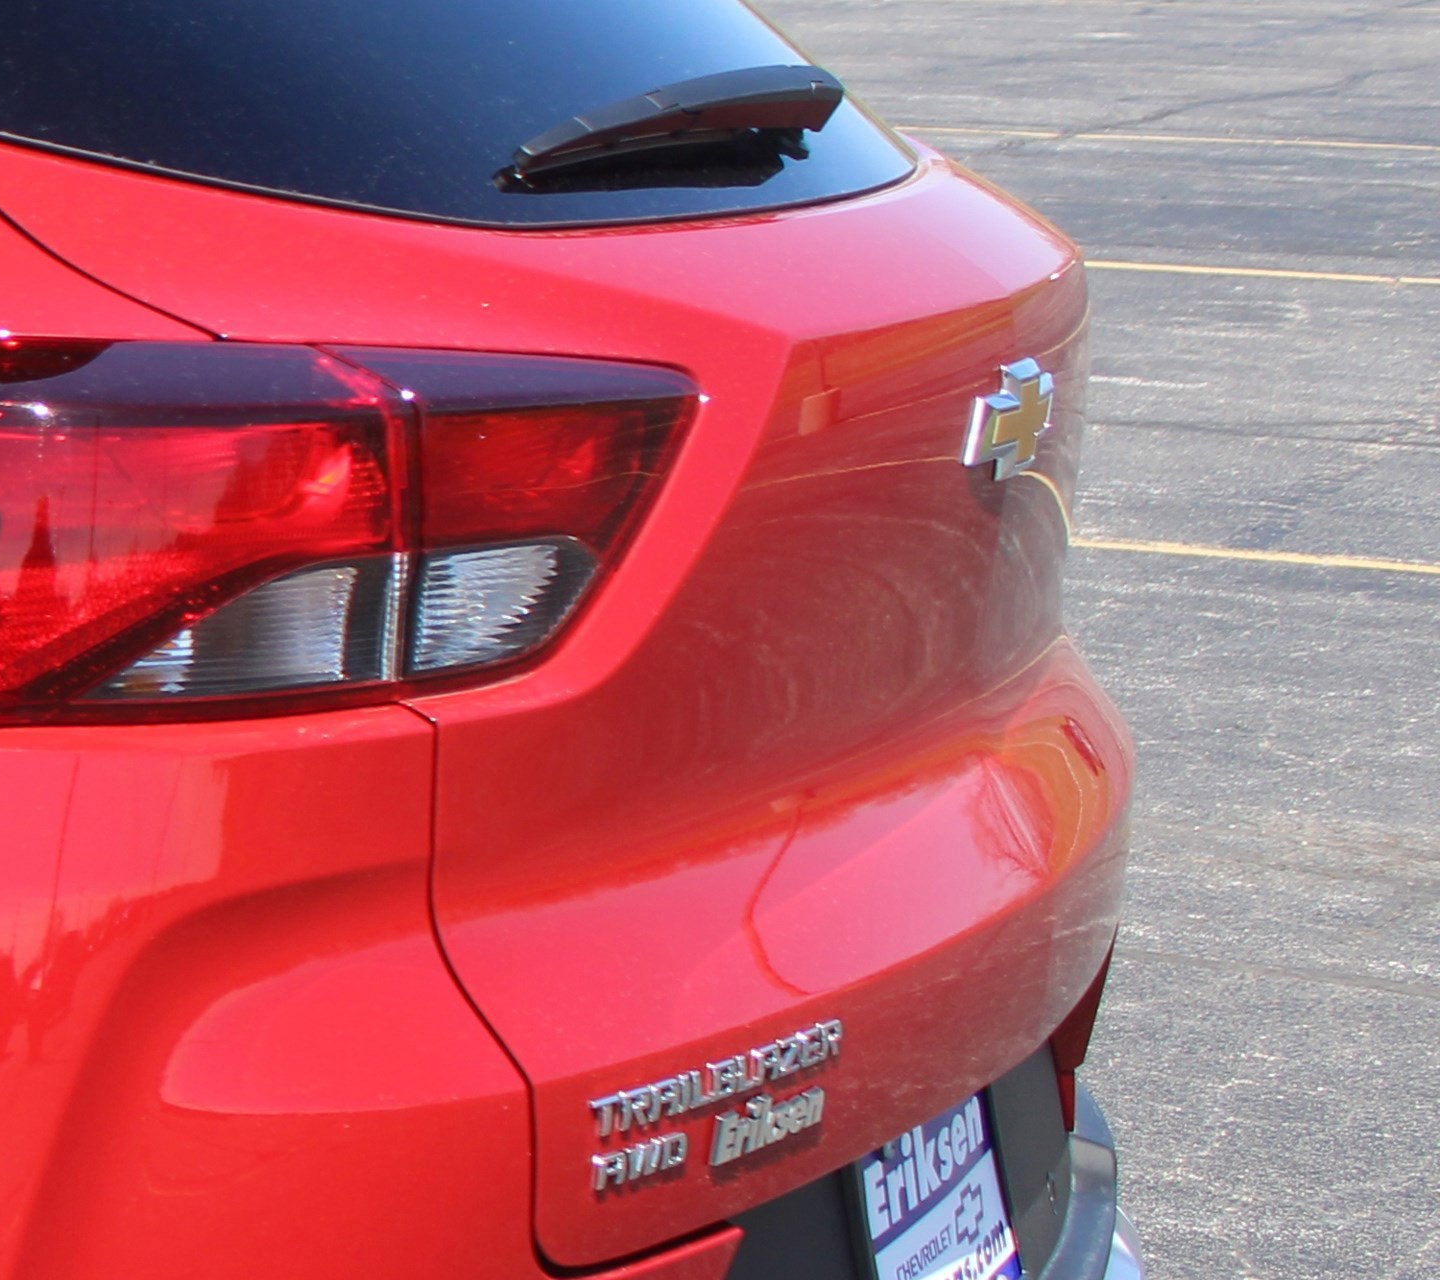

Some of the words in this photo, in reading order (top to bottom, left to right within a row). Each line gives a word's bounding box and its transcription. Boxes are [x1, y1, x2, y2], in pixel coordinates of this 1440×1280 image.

[588, 1019, 843, 1137] TRAILBLAZER
[708, 1086, 826, 1167] Eriksen
[591, 1131, 688, 1190] AWD
[863, 1094, 985, 1241] Eriksen
